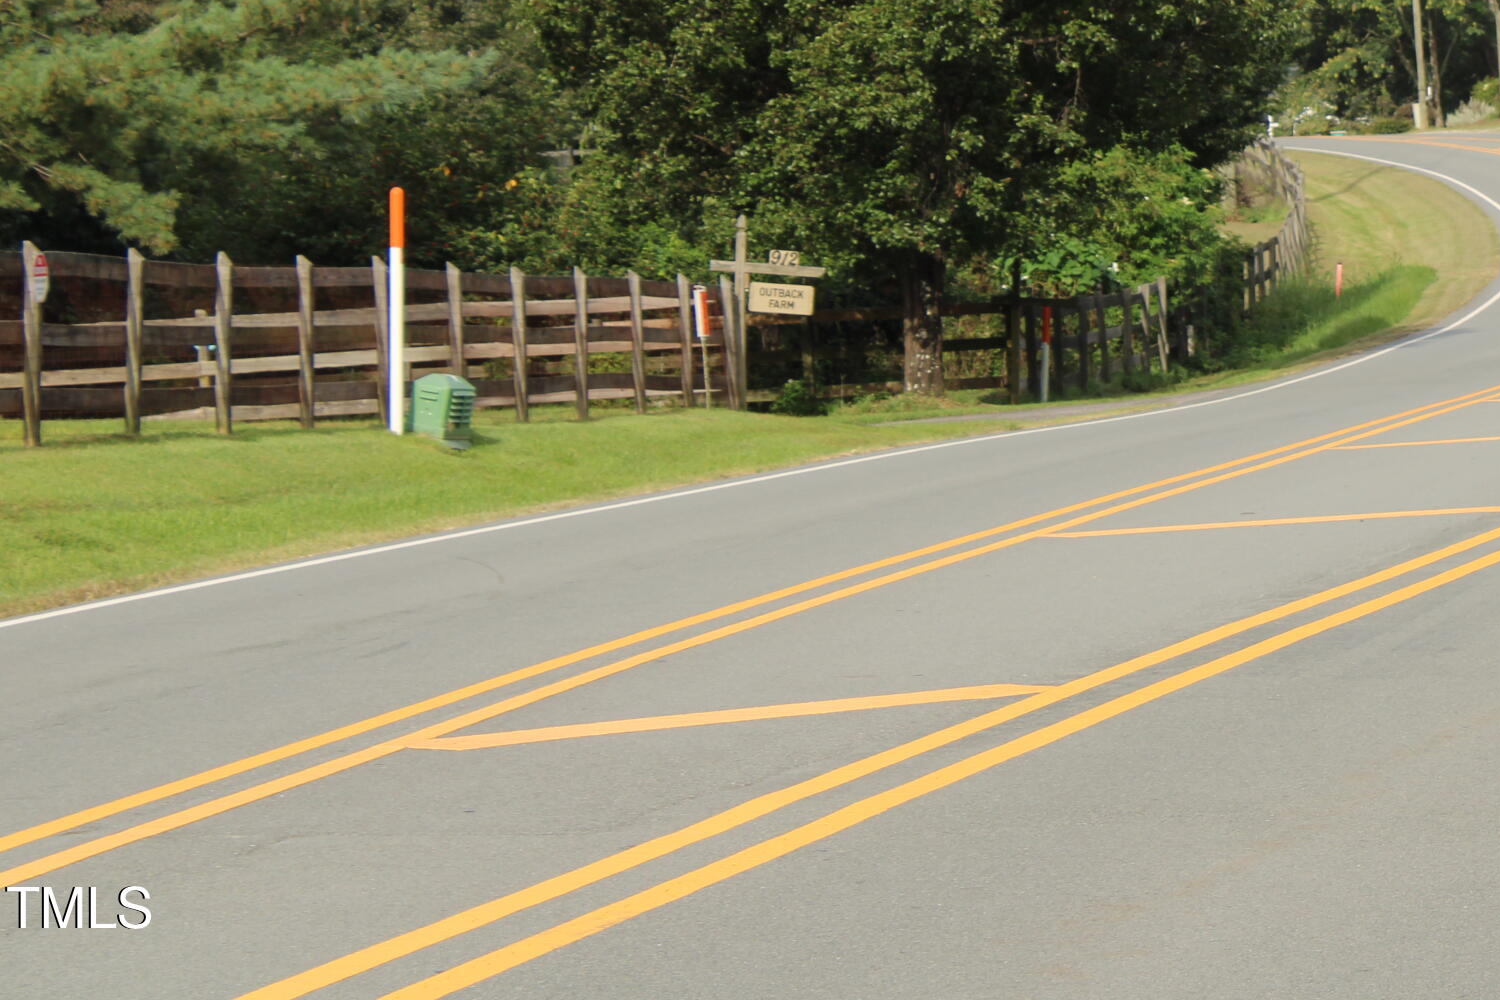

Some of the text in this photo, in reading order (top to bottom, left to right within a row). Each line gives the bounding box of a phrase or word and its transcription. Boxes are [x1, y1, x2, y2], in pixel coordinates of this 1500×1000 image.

[770, 249, 799, 266] 912
[759, 287, 804, 299] OUTBACK
[768, 299, 795, 309] FARM
